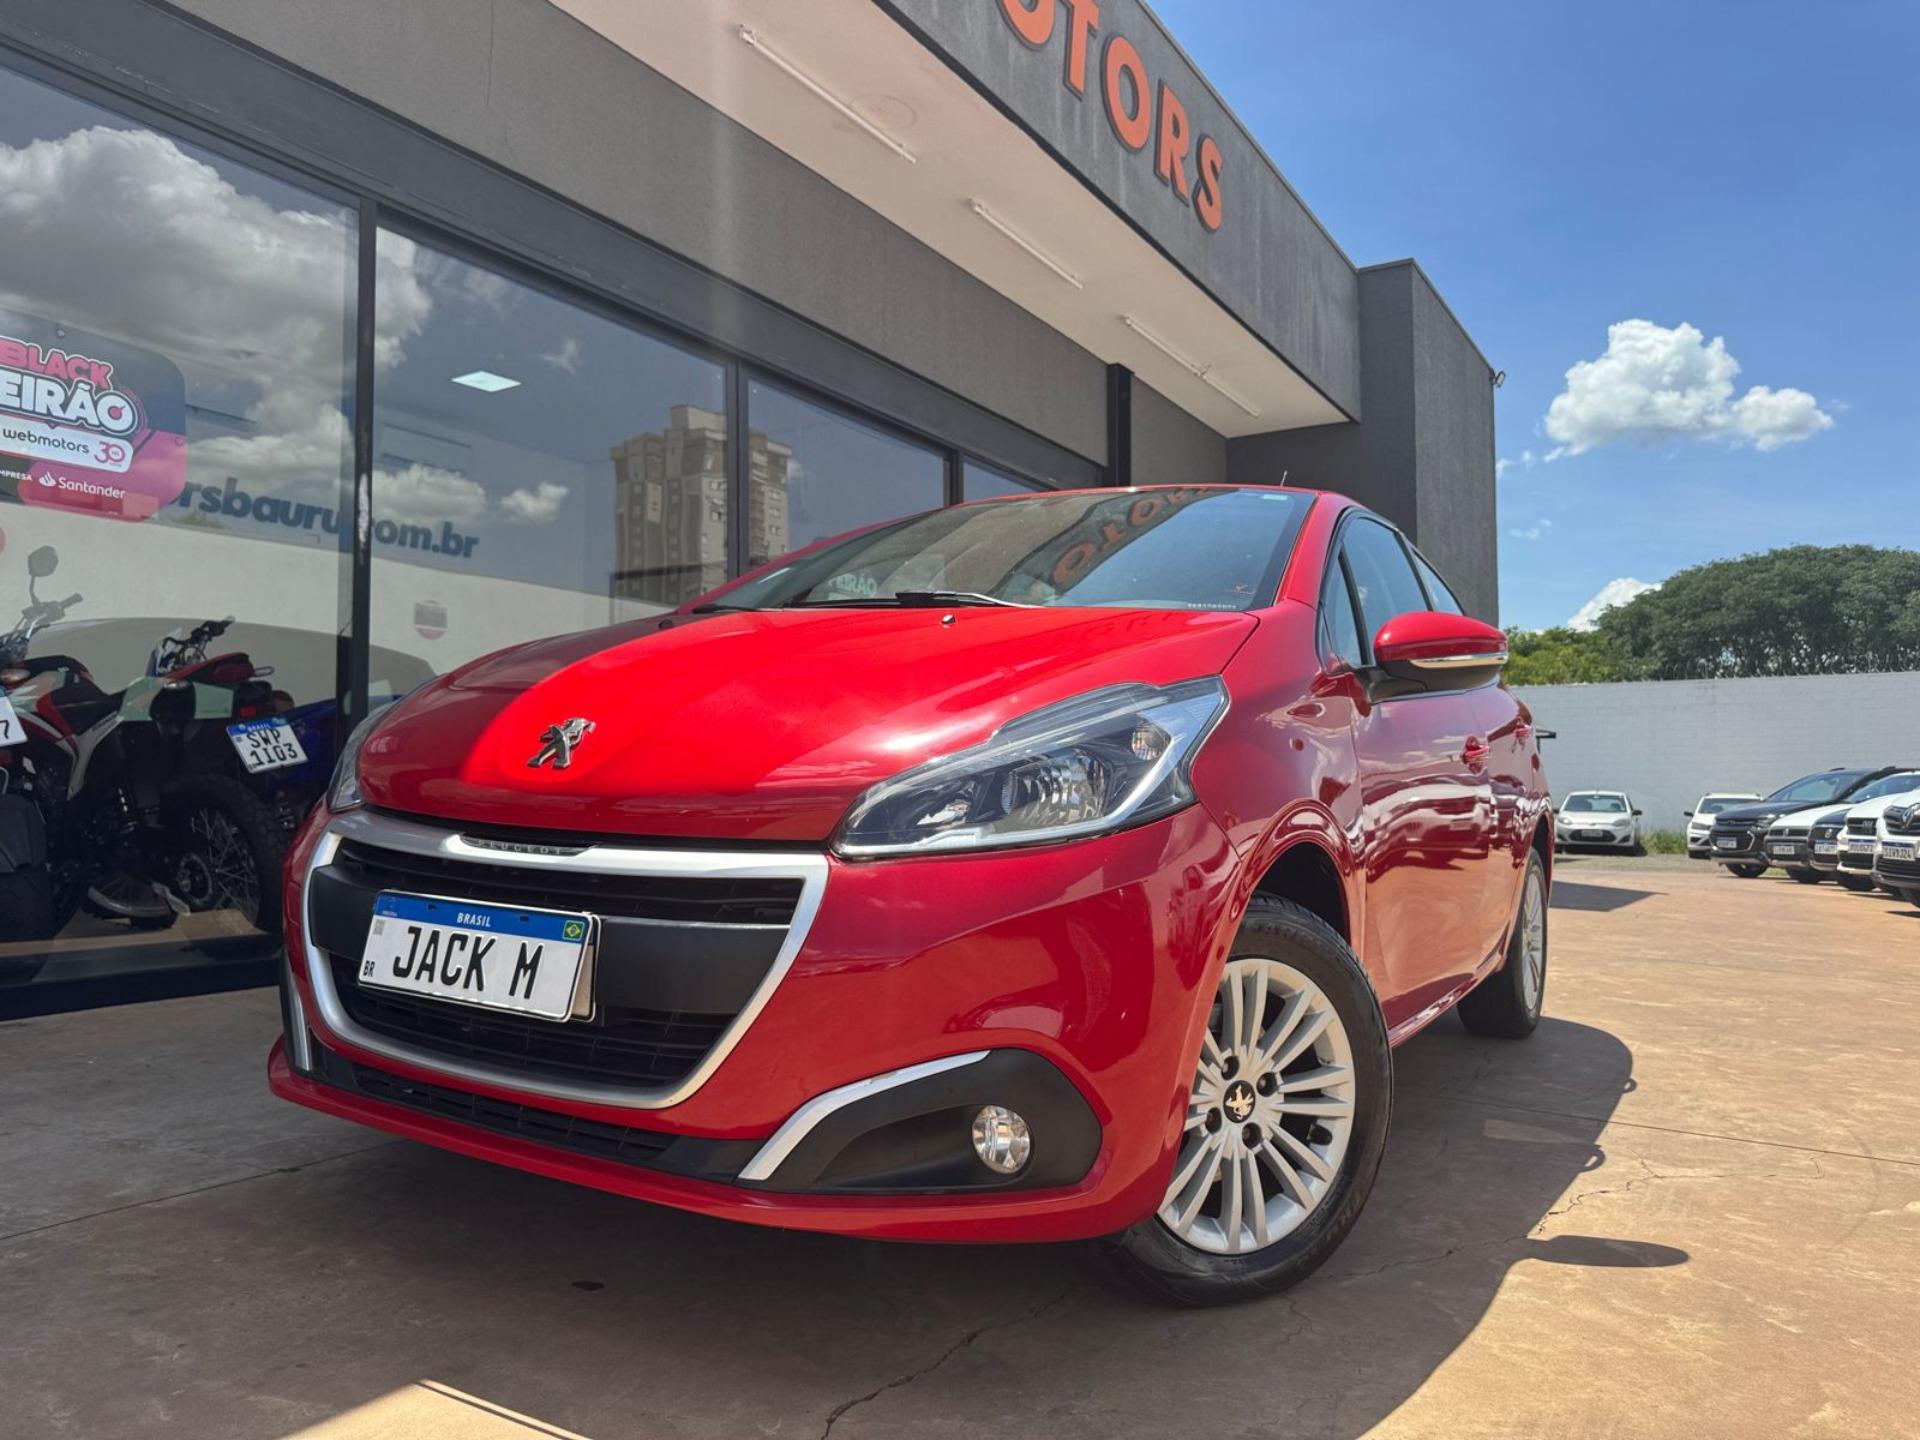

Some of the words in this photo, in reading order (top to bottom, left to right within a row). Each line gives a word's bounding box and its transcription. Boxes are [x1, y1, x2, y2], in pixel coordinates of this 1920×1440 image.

[3, 428, 90, 454] webmotors
[94, 441, 126, 464] 30
[58, 477, 126, 499] Santander
[246, 728, 281, 748] SWP
[456, 912, 491, 928] BRASIL
[363, 960, 375, 978] BR
[393, 926, 496, 991] JACK
[509, 941, 544, 999] M
